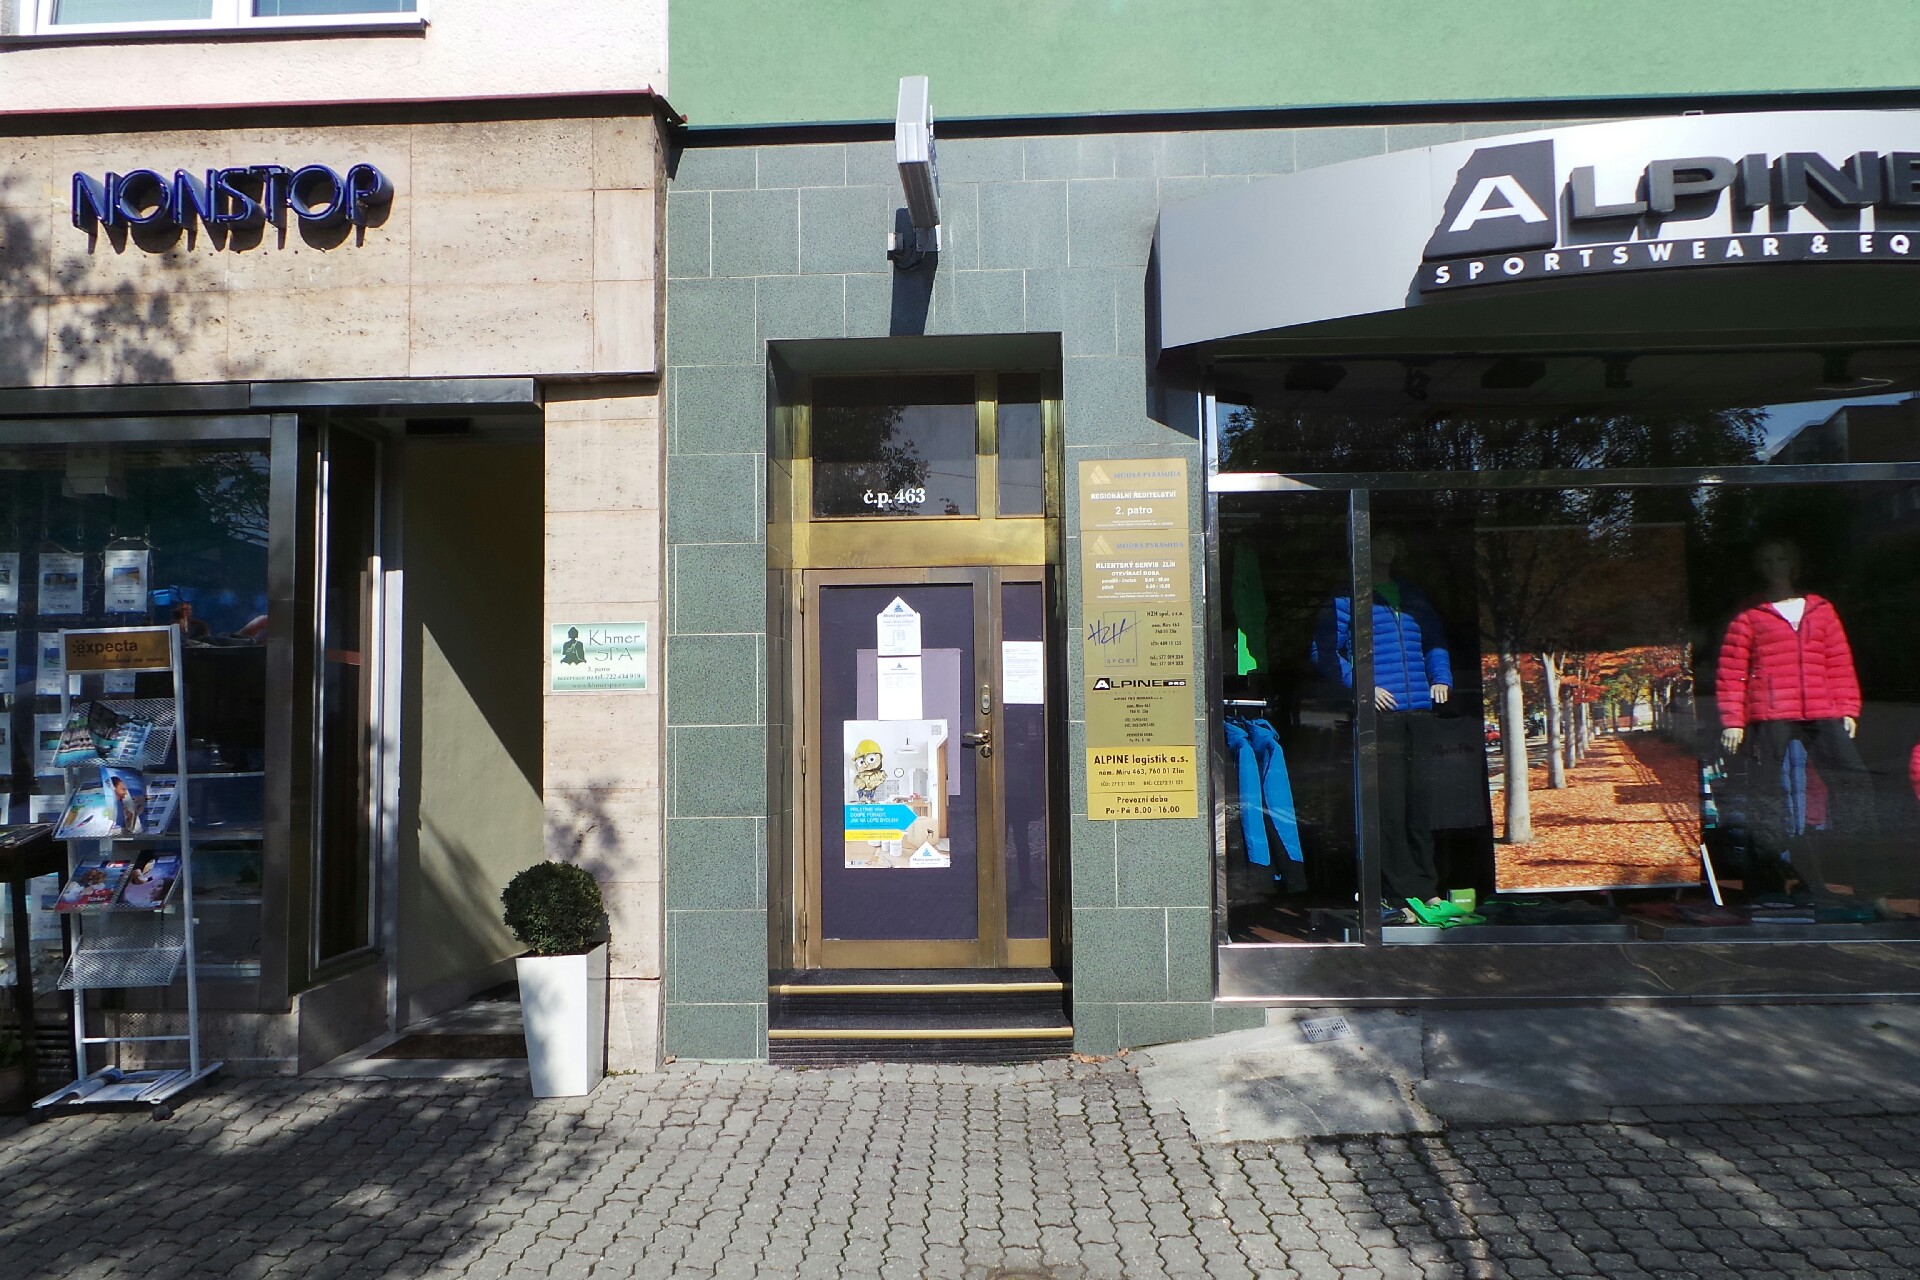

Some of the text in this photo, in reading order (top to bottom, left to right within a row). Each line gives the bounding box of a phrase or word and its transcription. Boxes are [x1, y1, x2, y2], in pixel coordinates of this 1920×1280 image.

[72, 163, 387, 228] NONSTOP
[1434, 237, 1780, 285] SPORTSWEAR
[1810, 234, 1830, 254] &
[863, 487, 926, 508] č.p. 463
[1115, 506, 1153, 516] 2. patro
[589, 629, 641, 646] Khmer
[1093, 678, 1163, 690] ALPINE
[1094, 754, 1189, 766] ALPINE logistik a.s.
[1132, 768, 1147, 776] 463,
[1150, 794, 1168, 803] doba
[1158, 806, 1180, 814] 16.00
